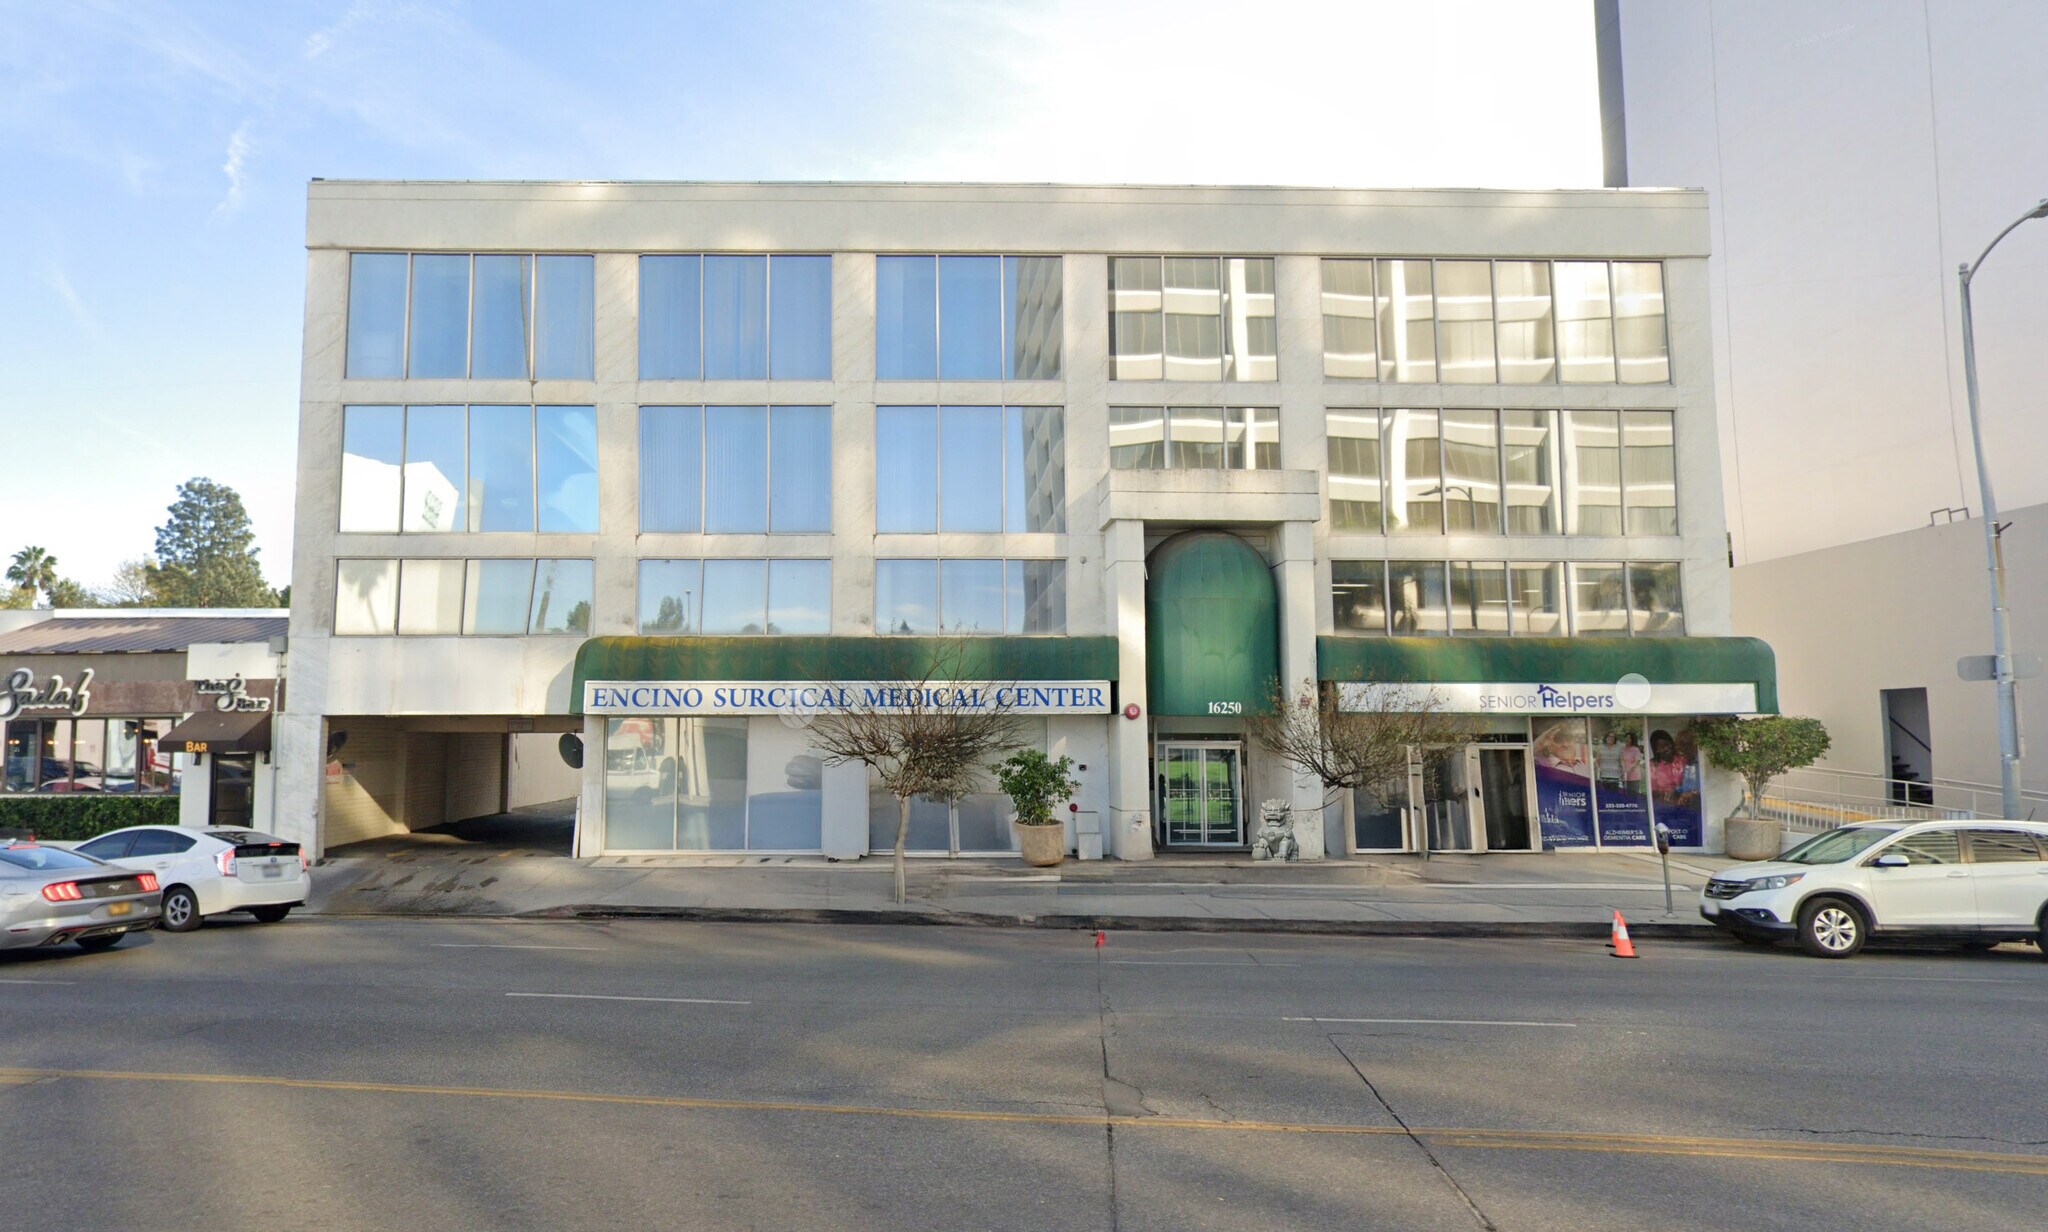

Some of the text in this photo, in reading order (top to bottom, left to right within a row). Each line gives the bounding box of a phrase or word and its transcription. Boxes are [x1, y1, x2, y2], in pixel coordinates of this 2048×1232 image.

[0, 668, 94, 721] Sadaf
[195, 679, 227, 694] The
[236, 696, 271, 711] Bar
[590, 687, 704, 708] ENCINO
[861, 687, 986, 708] MEDICAL
[995, 687, 1106, 708] CENTER
[1479, 689, 1614, 711] SENIOR Helpers
[1207, 701, 1242, 715] 16250
